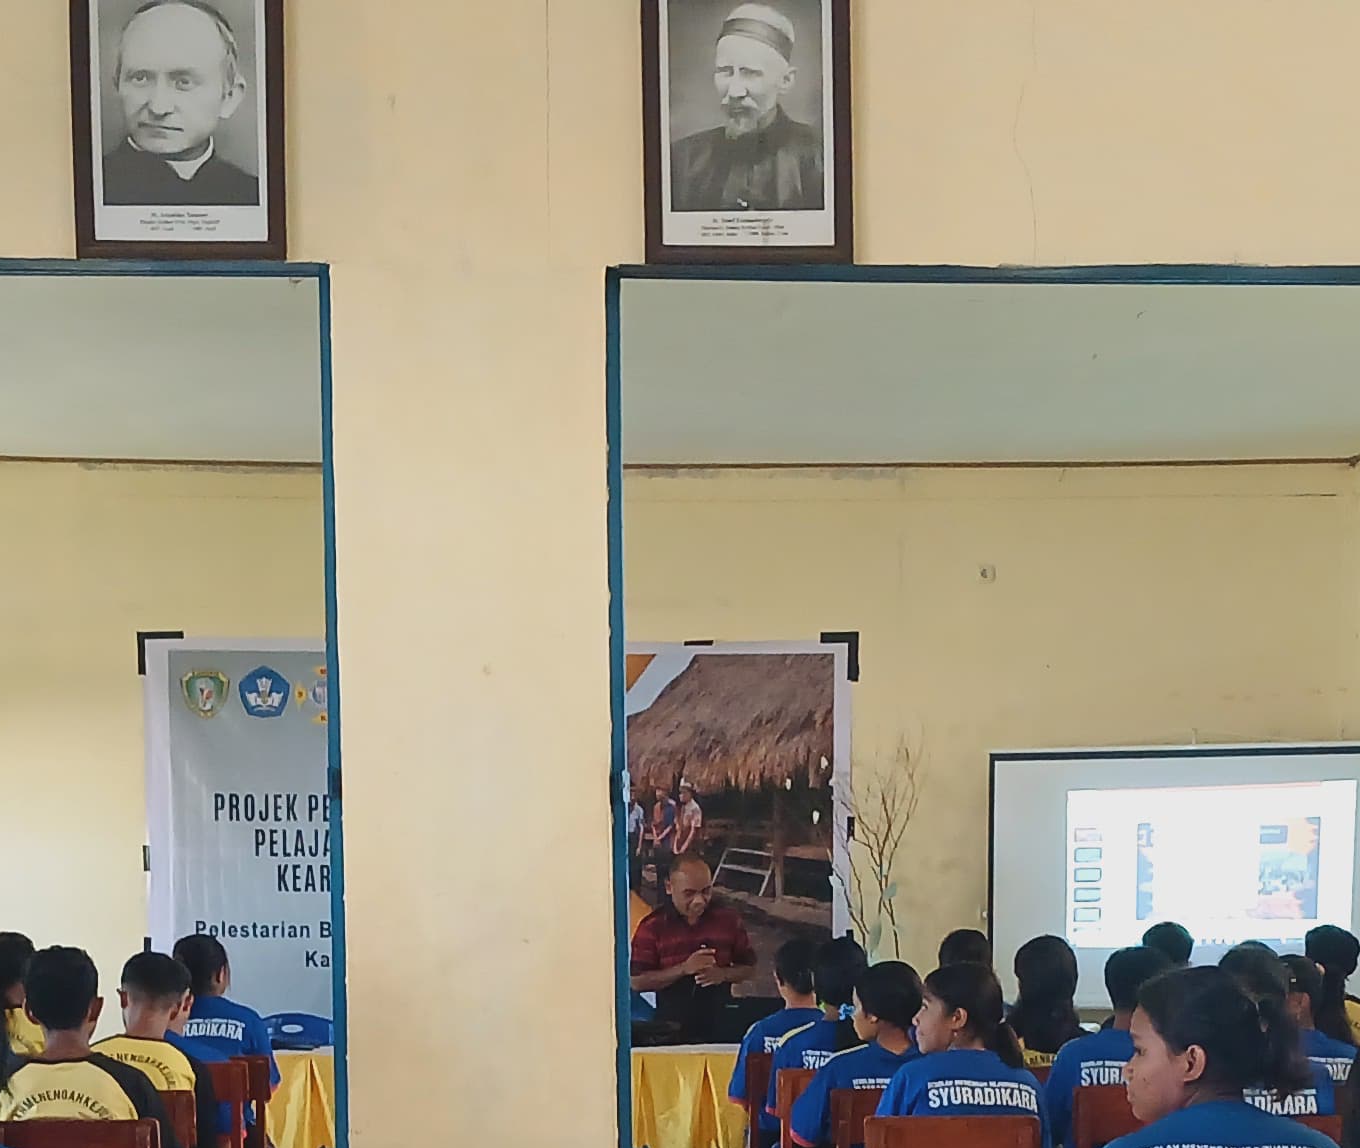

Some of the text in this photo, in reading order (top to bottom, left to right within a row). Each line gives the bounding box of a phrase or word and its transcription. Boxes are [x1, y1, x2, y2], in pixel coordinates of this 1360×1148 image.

[214, 793, 298, 822] PROJEK
[277, 863, 330, 892] KEAR
[320, 921, 331, 938] B
[305, 950, 330, 967] Ka
[928, 1086, 1038, 1113] SYURADIKARA
